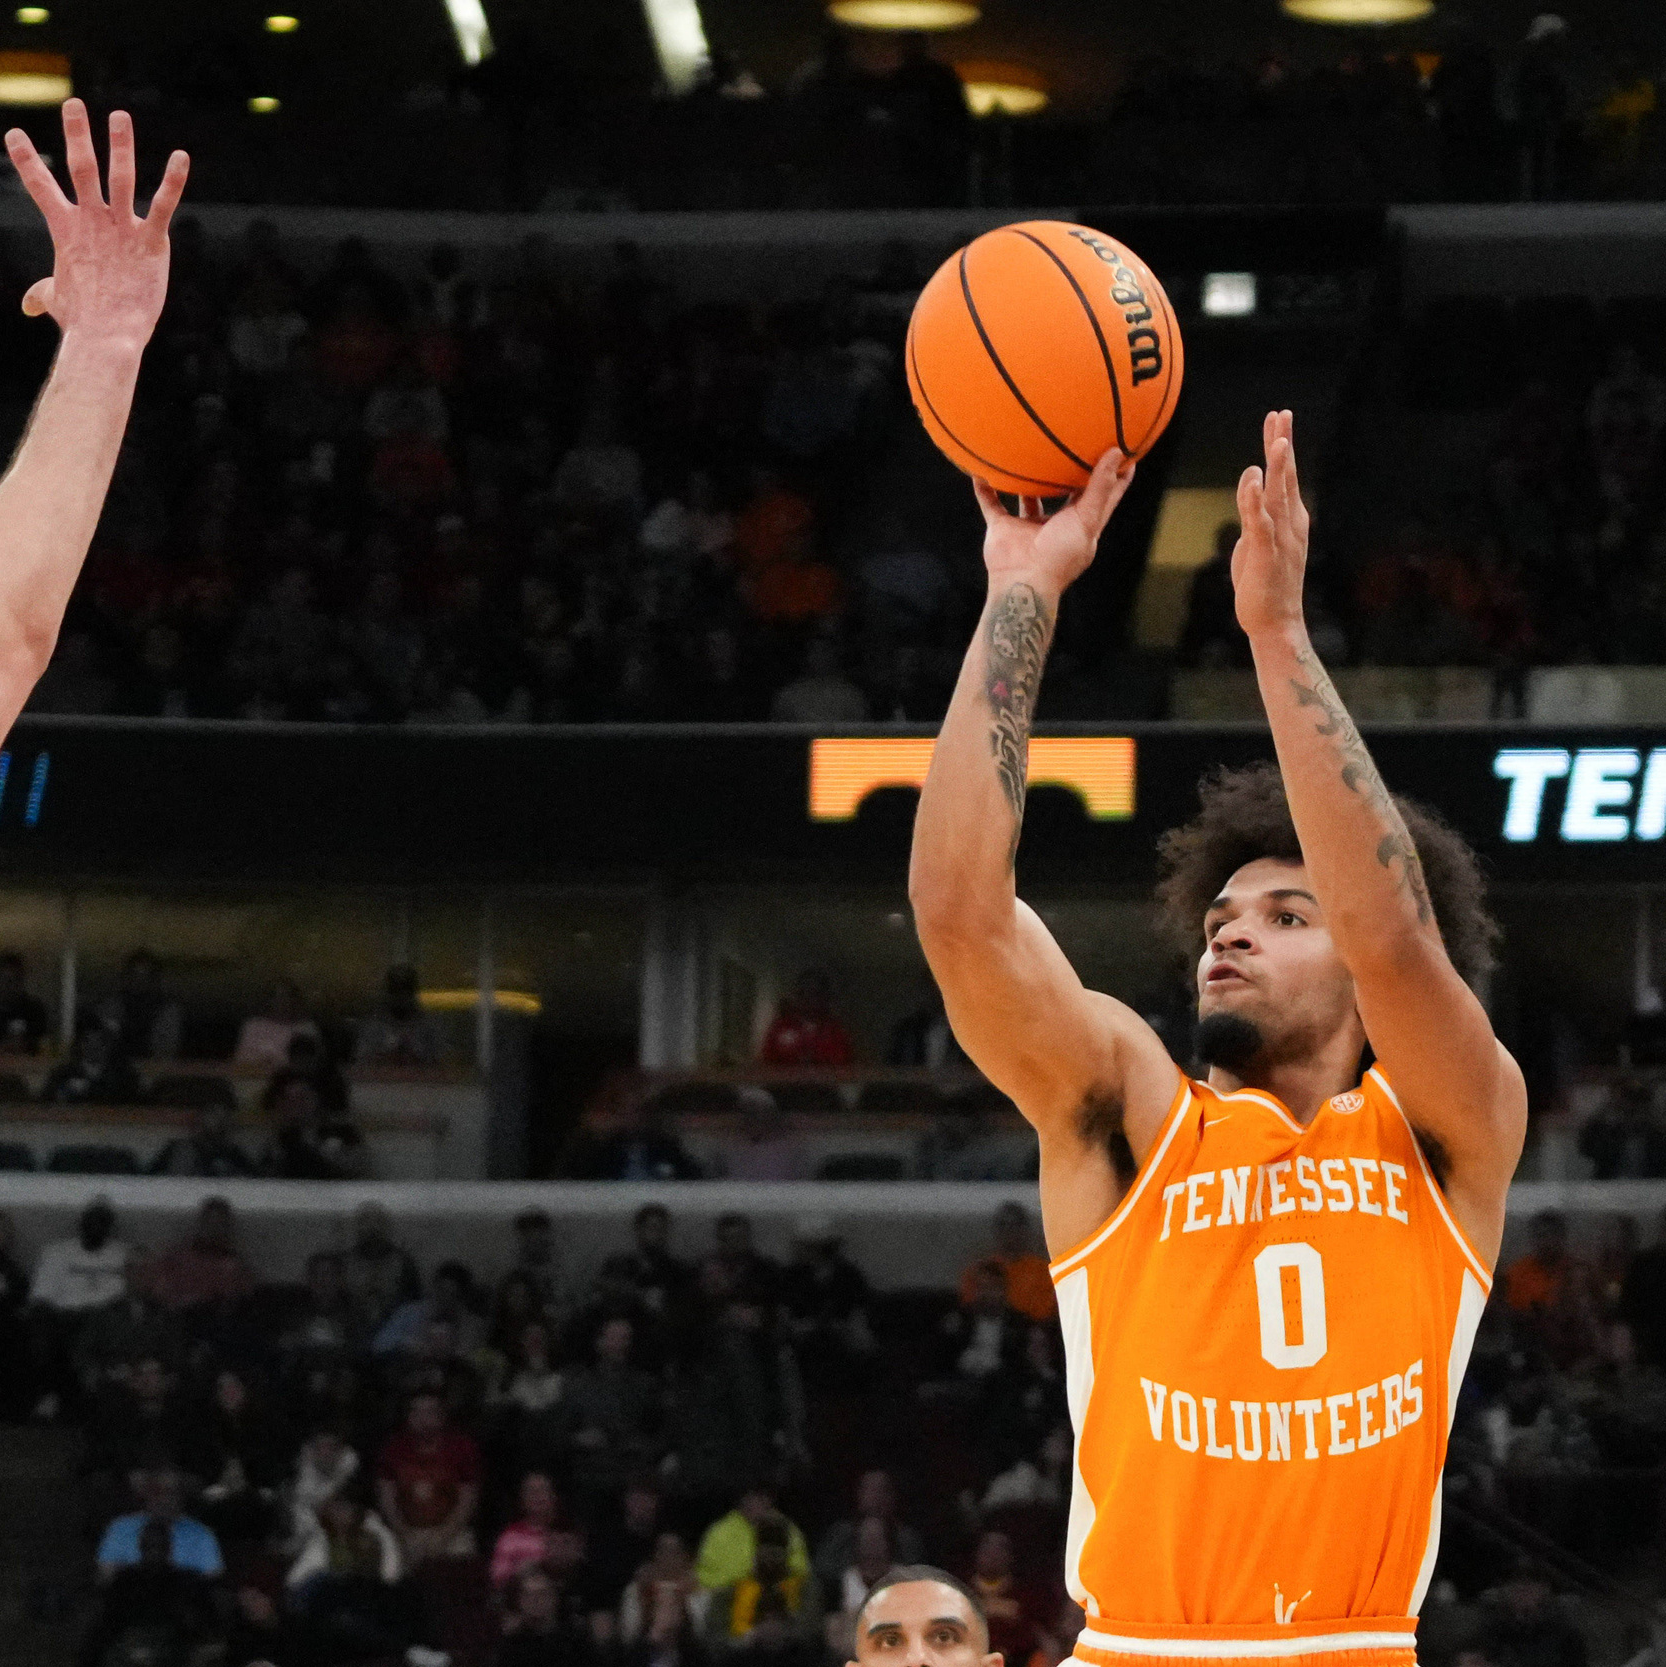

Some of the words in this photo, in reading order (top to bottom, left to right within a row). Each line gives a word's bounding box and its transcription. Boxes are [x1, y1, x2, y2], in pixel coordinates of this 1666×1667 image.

[1067, 229, 1163, 388] Wilson
[1331, 1093, 1363, 1113] SEC
[1253, 1241, 1328, 1370] 0
[1139, 1357, 1424, 1462] VOLUNTEERS
